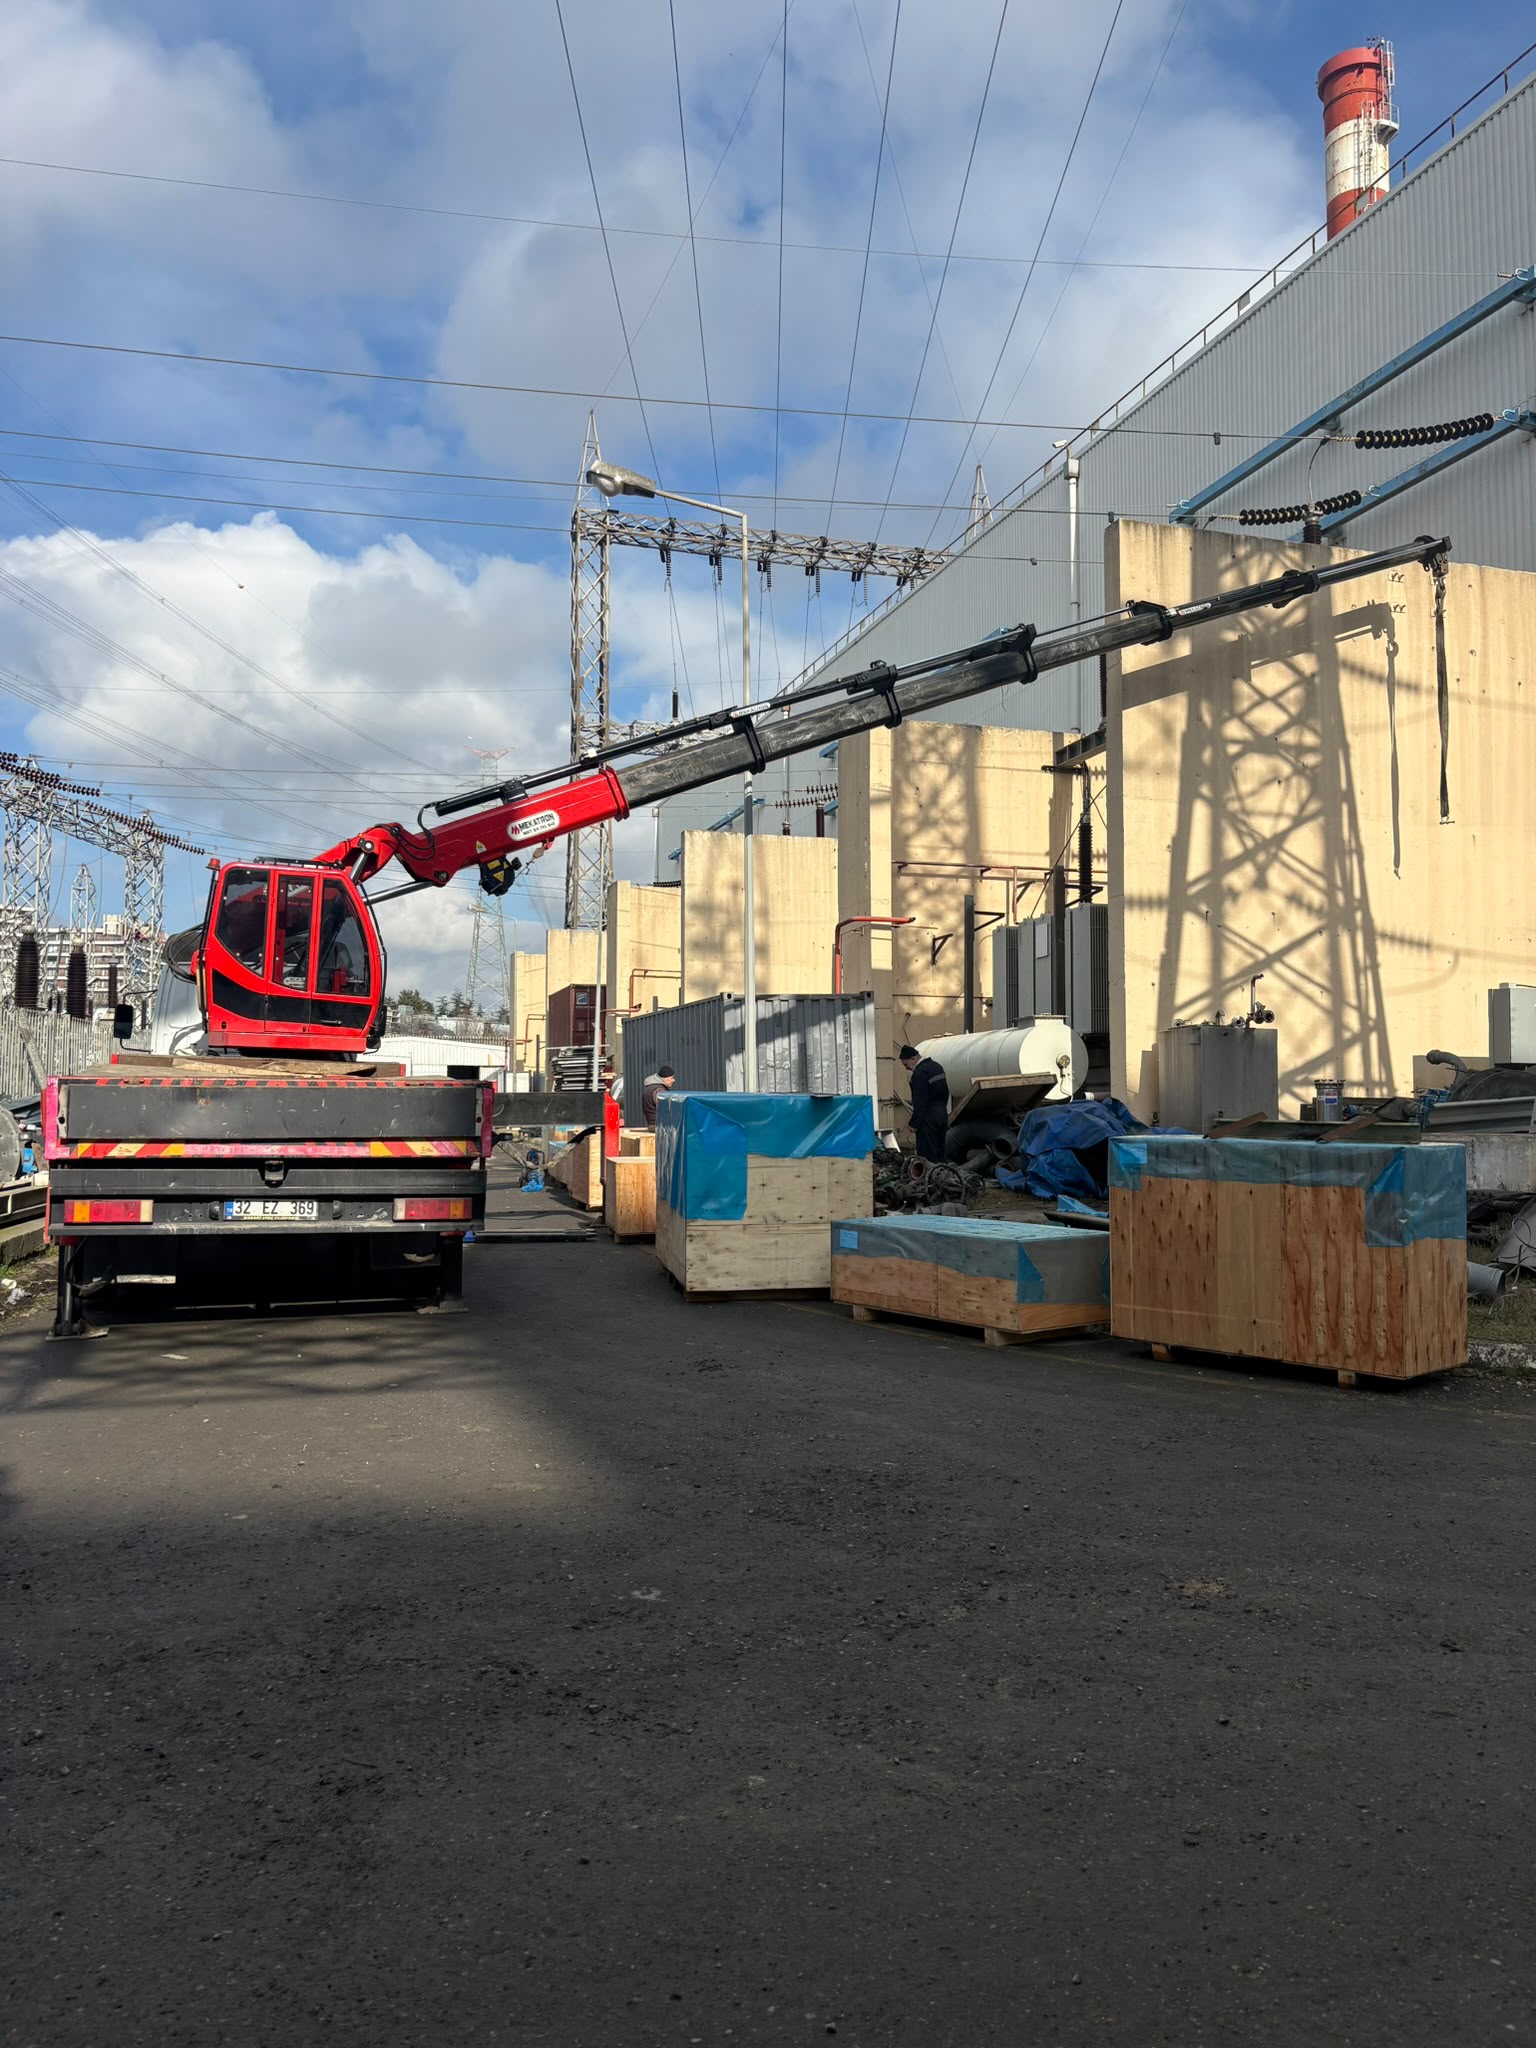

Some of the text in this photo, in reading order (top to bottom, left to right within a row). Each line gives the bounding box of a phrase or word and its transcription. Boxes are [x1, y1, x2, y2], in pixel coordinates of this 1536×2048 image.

[518, 812, 555, 831] MEKATRON
[235, 1200, 314, 1215] 32 EZ 369
